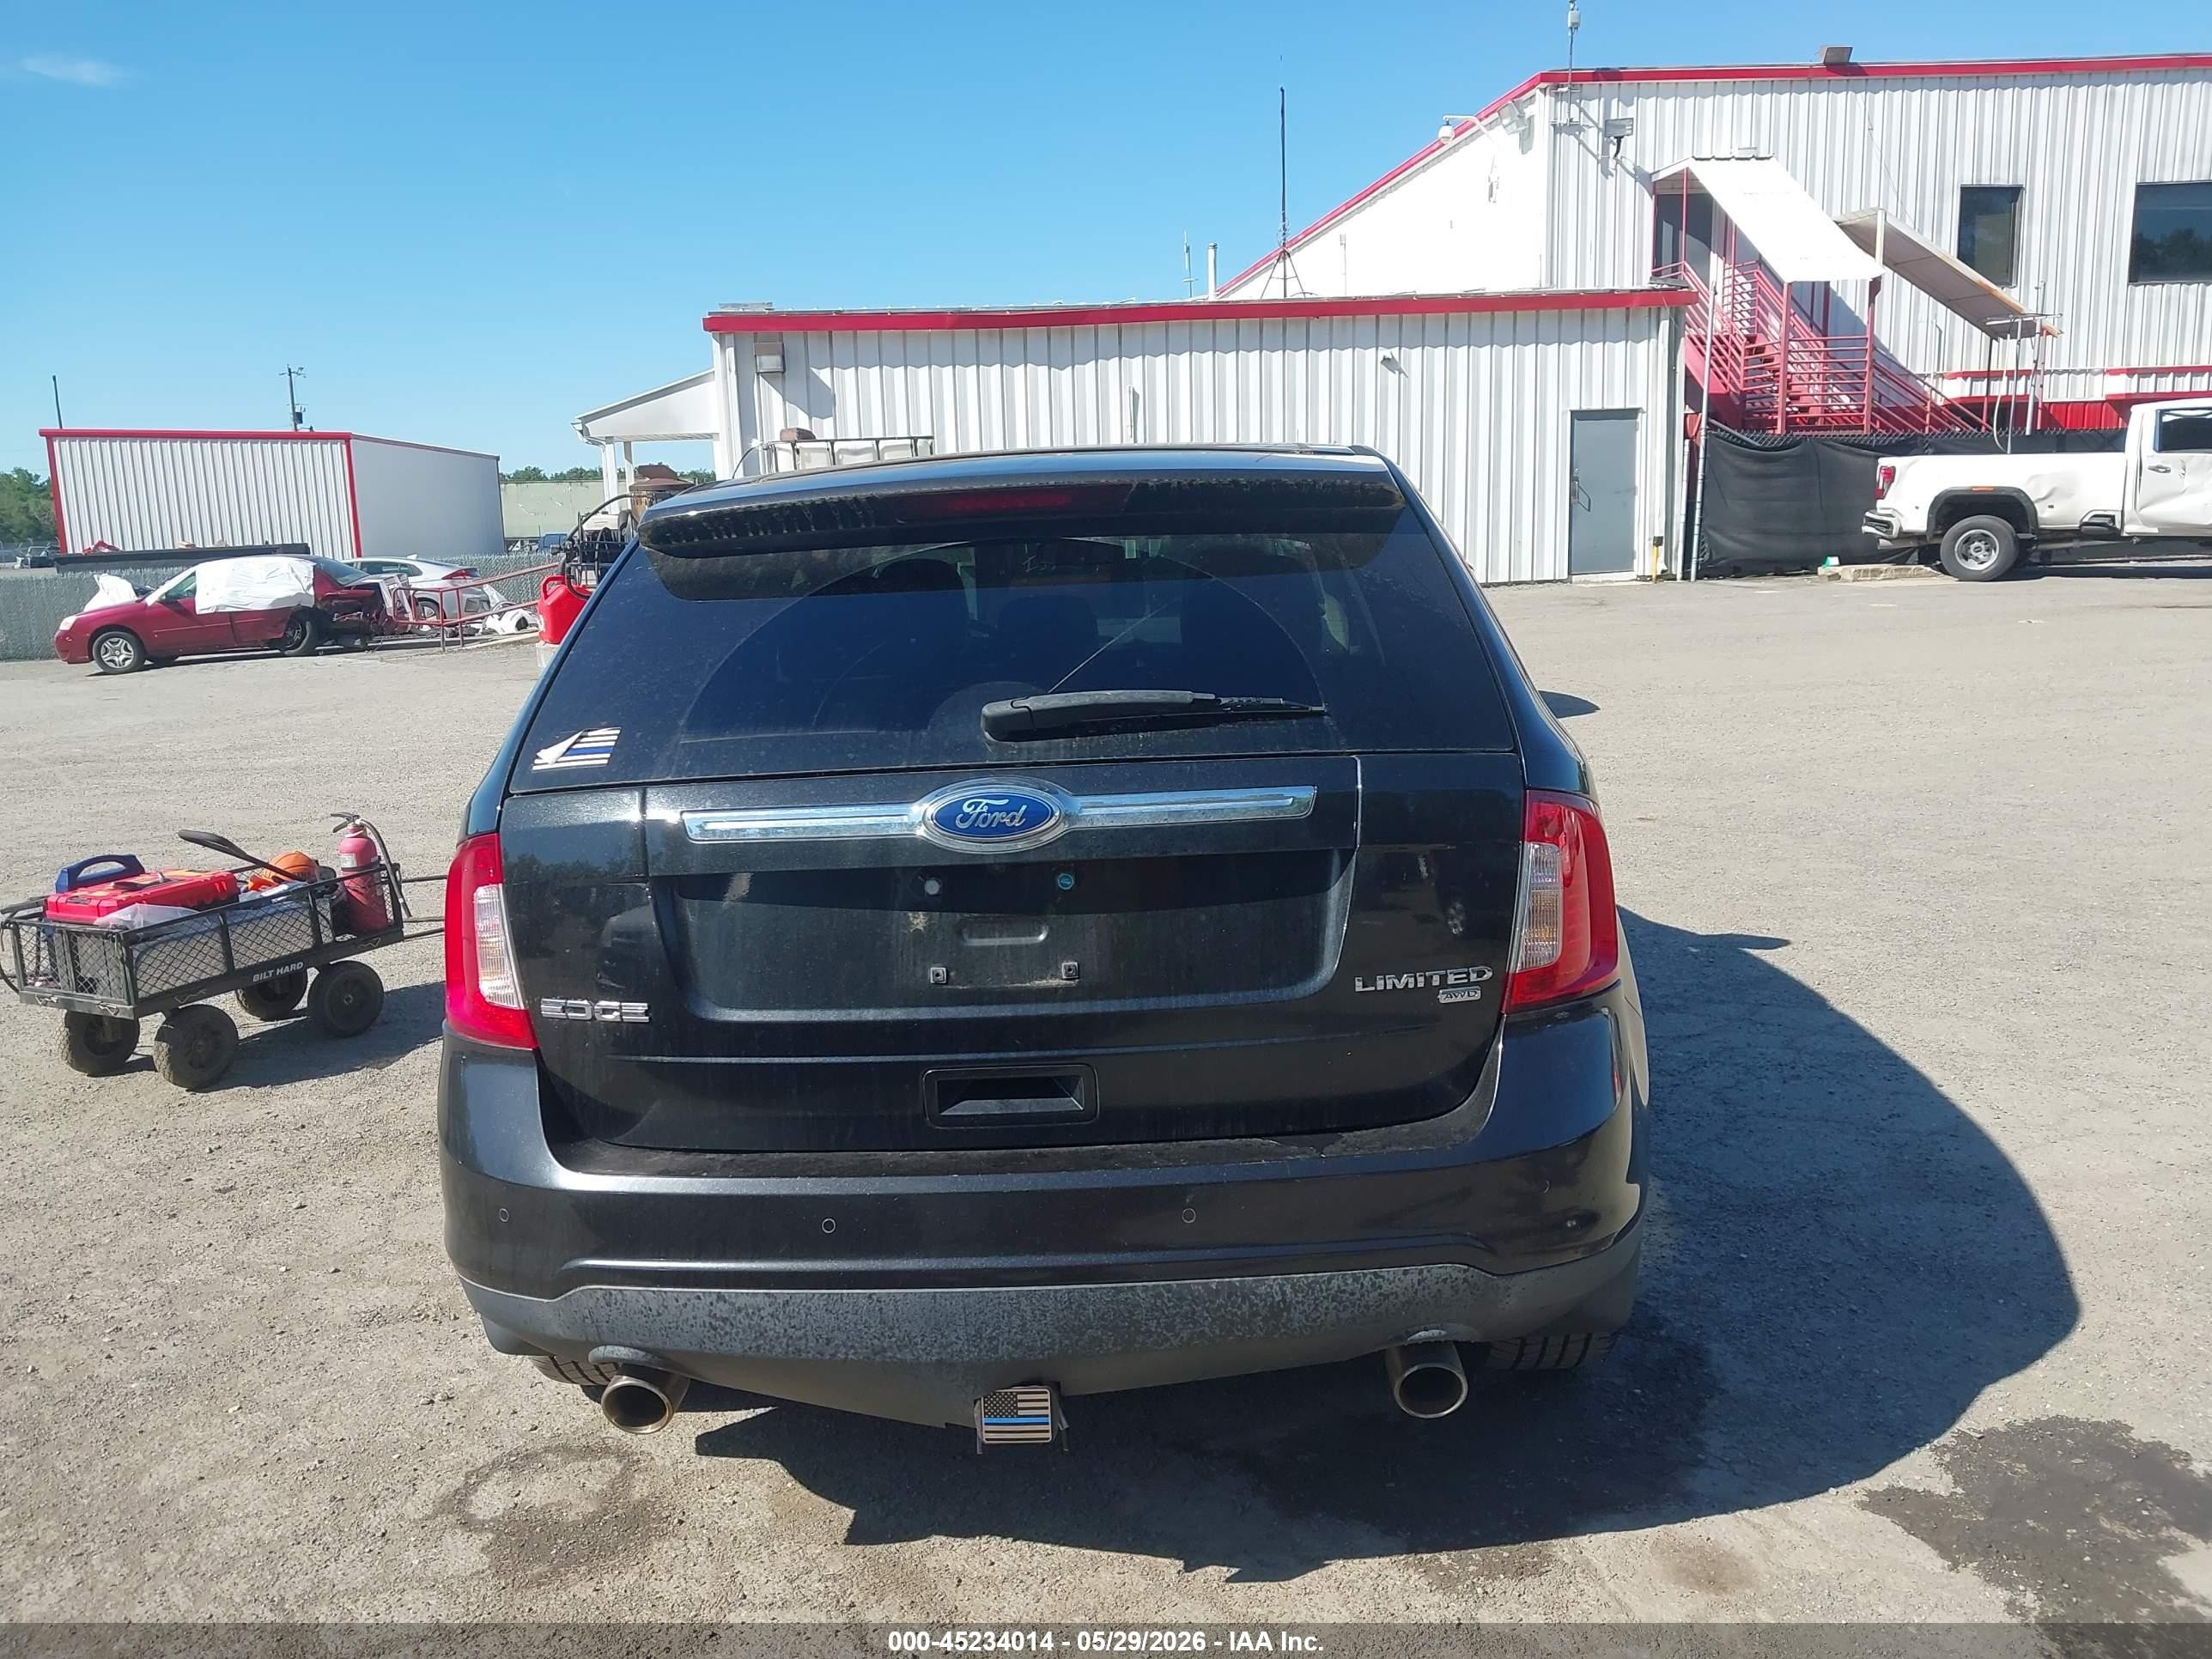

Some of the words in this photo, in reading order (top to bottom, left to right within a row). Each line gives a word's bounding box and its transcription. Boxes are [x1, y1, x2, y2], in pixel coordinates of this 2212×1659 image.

[955, 799, 1027, 829] Ford
[252, 969, 274, 982] BILT
[276, 962, 304, 975] HARD
[1354, 965, 1493, 992] LIMITED
[1443, 989, 1478, 1001] AWD
[540, 998, 650, 1023] EDGE
